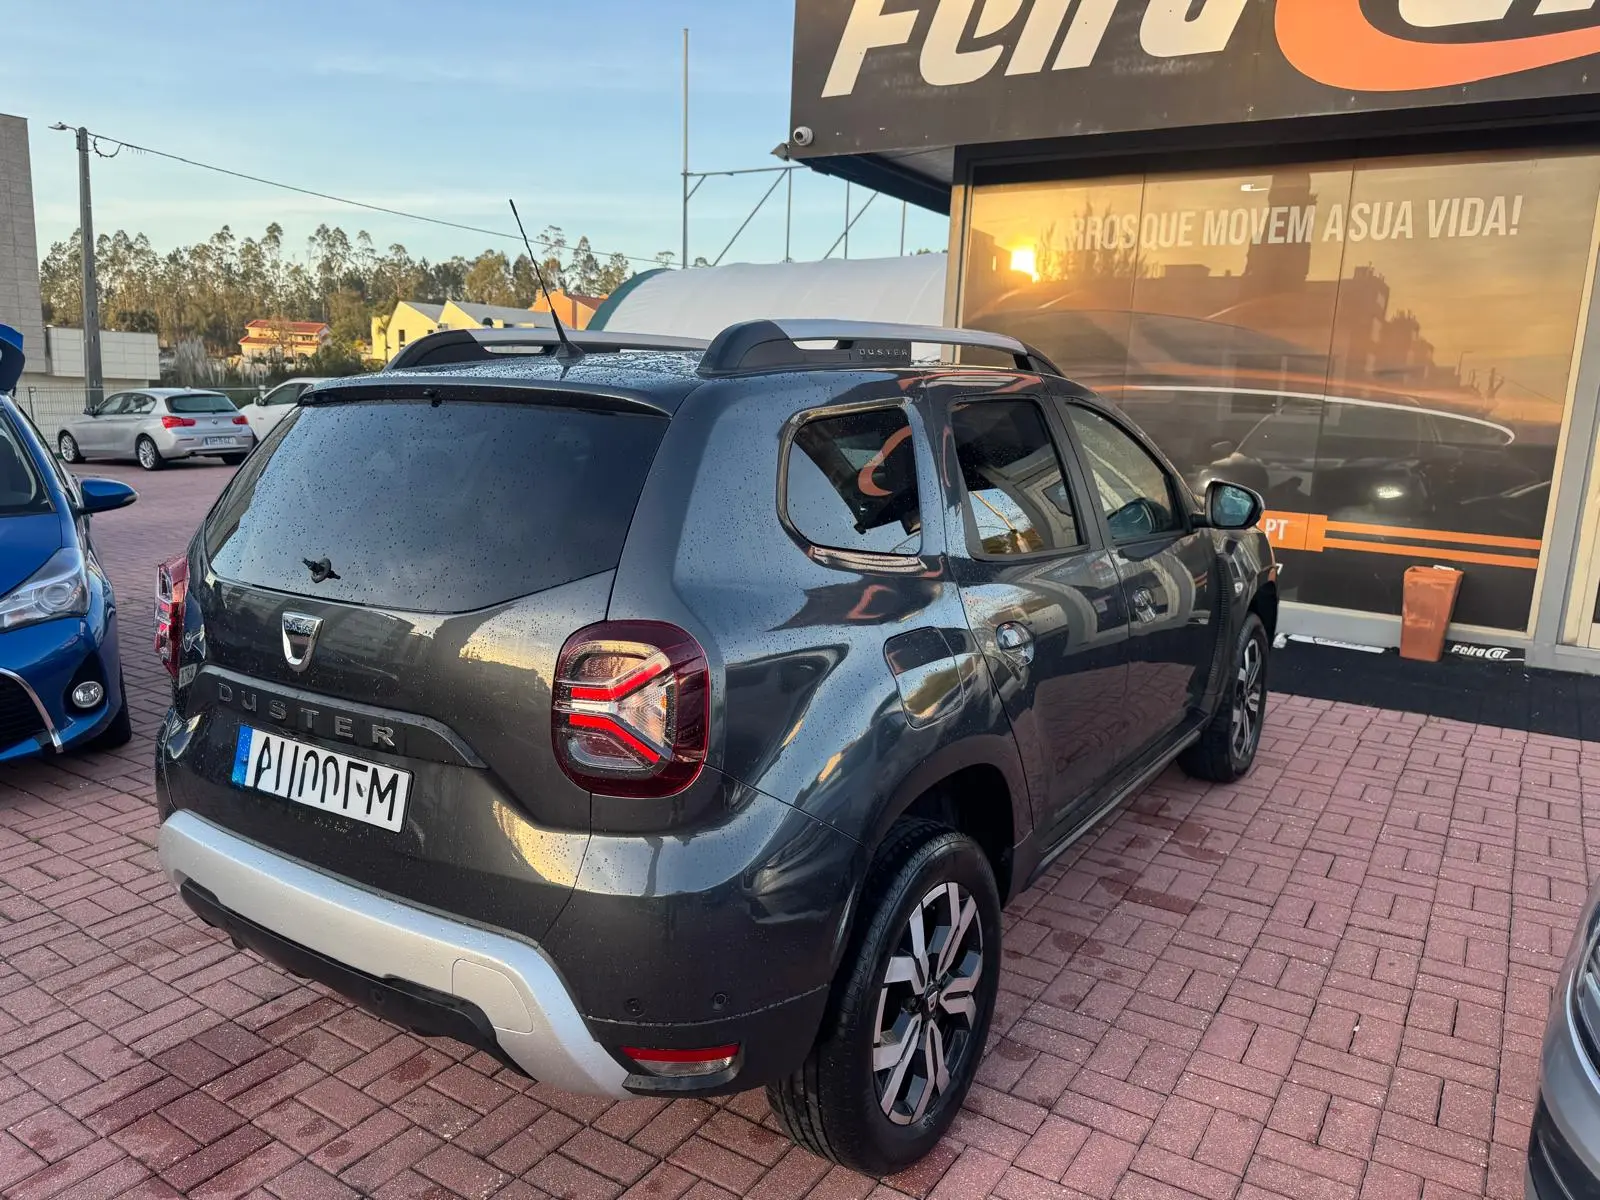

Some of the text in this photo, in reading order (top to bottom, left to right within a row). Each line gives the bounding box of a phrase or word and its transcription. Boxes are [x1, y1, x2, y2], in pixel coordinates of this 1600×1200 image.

[1140, 211, 1196, 251] QUE
[1202, 205, 1316, 246] MOVEM
[1348, 200, 1414, 242] SUA
[1428, 195, 1524, 239] VIDA!
[859, 348, 908, 356] DUSTER
[217, 682, 396, 748] DUSTER
